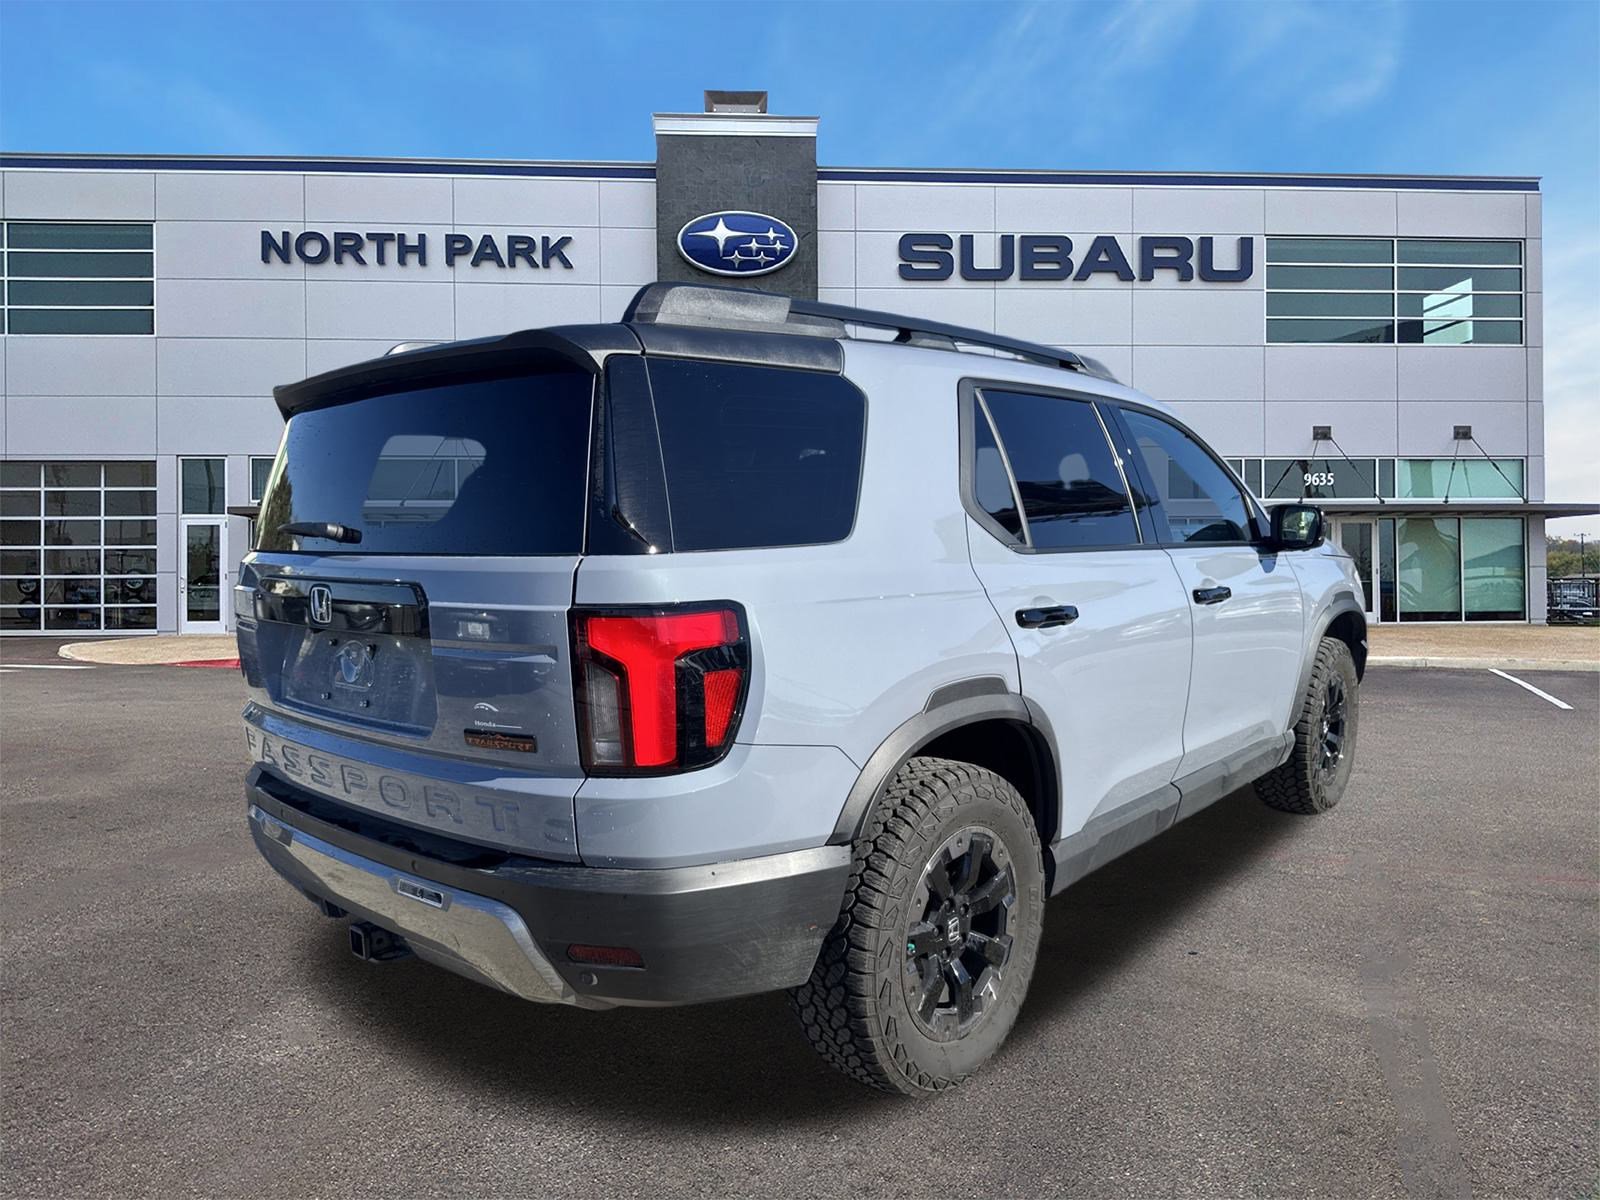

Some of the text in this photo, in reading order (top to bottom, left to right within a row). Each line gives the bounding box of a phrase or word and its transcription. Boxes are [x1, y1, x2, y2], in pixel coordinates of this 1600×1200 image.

[260, 230, 574, 269] NORTH PARK
[898, 233, 1254, 282] SUBARU
[1303, 472, 1335, 486] 9635
[474, 719, 496, 728] Honda
[245, 726, 520, 832] PASSPORT
